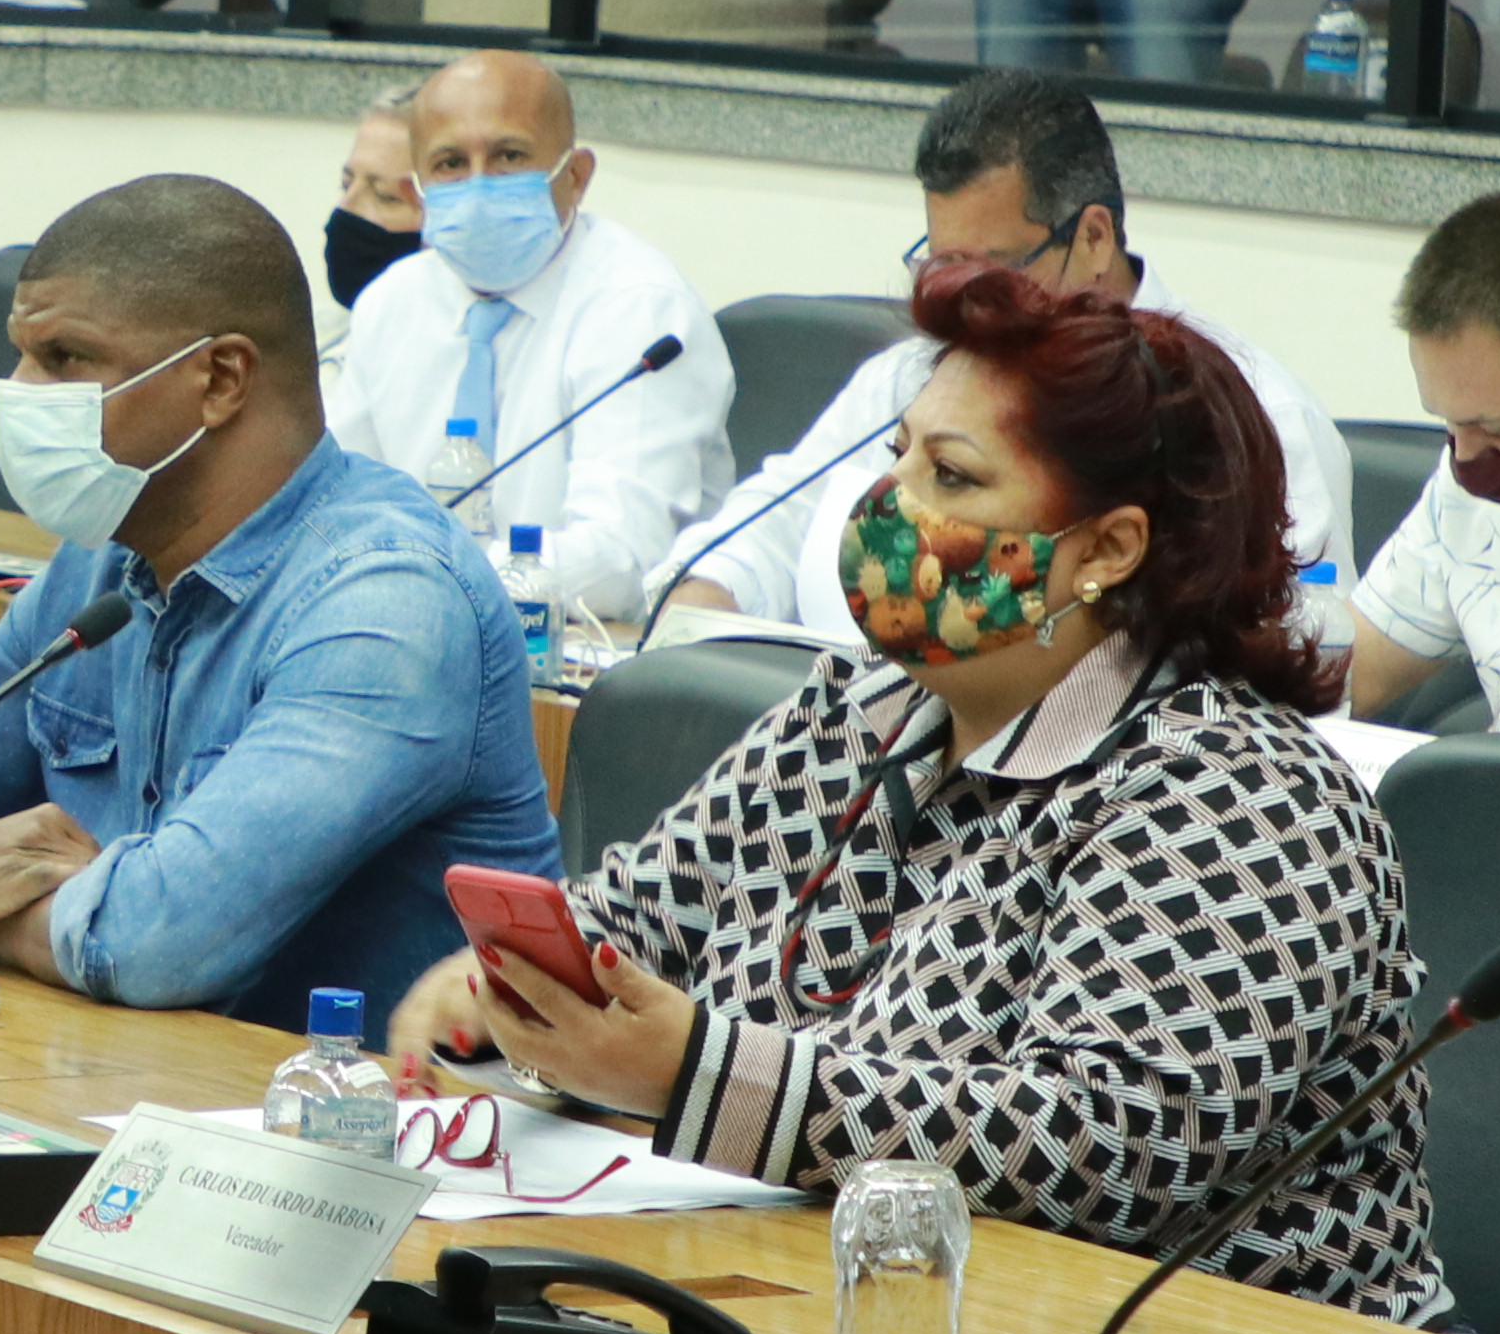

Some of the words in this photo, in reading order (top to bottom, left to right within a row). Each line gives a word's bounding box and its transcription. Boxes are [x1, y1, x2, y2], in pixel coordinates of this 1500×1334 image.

[178, 1165, 243, 1196] CARLOS
[237, 1180, 316, 1217] EDUARDO
[312, 1199, 387, 1236] BARBOSA
[223, 1223, 285, 1258] Vereador
